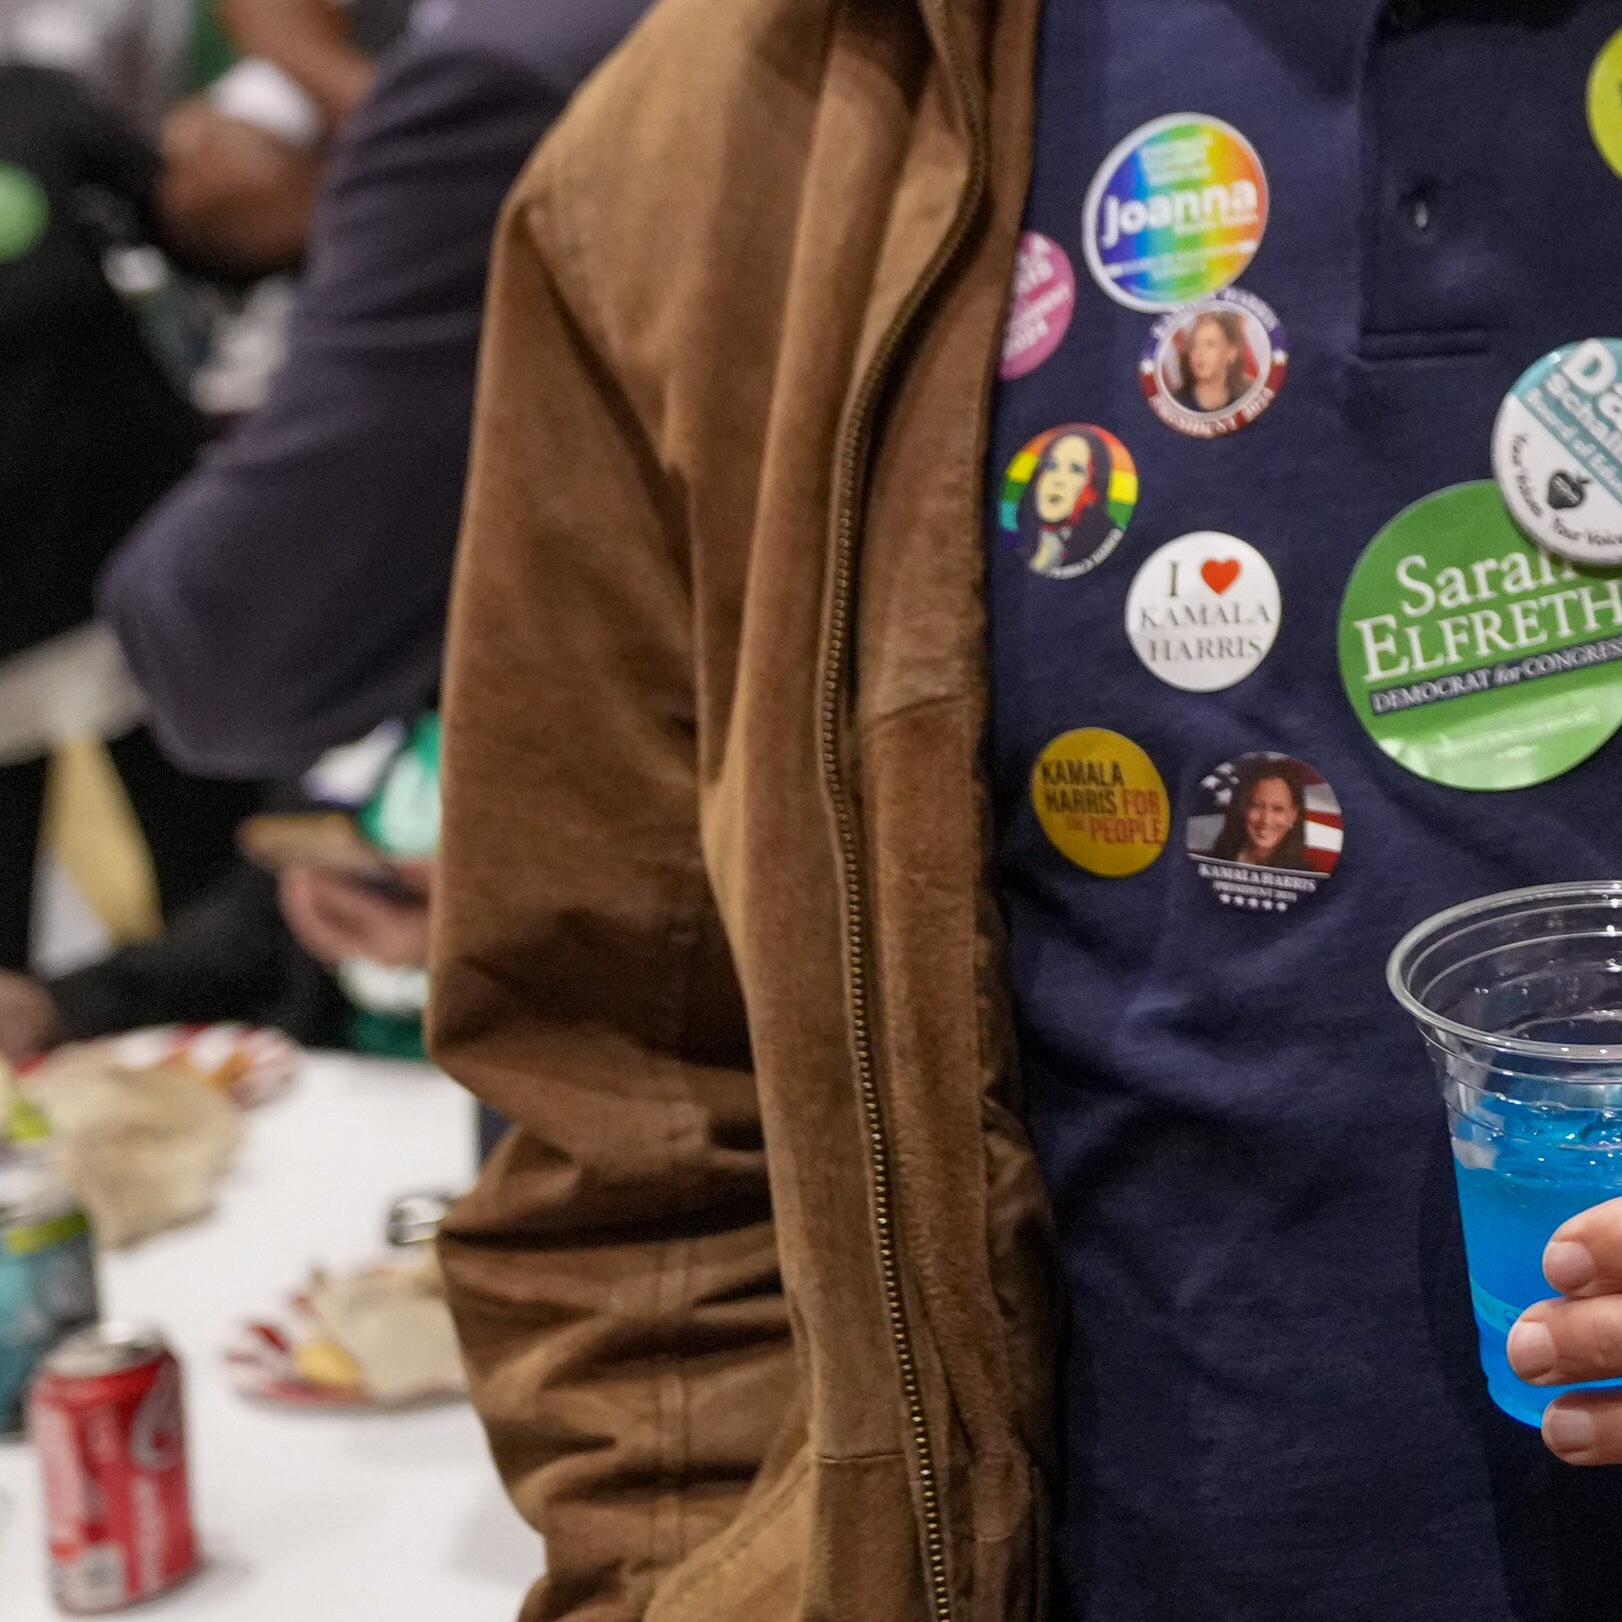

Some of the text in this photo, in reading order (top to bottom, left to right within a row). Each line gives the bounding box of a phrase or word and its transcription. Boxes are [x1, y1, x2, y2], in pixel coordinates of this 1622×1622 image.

[1102, 179, 1257, 249] Joanna
[1168, 560, 1179, 598] I
[1140, 602, 1271, 628] KAMALA
[1149, 634, 1263, 662] HARRIS
[1373, 667, 1491, 713] DEMOCRAT
[1493, 663, 1522, 685] for
[1042, 759, 1124, 787] KAMALA
[1045, 787, 1161, 816] HARRIS FOR
[1088, 816, 1165, 847] PEOPLE
